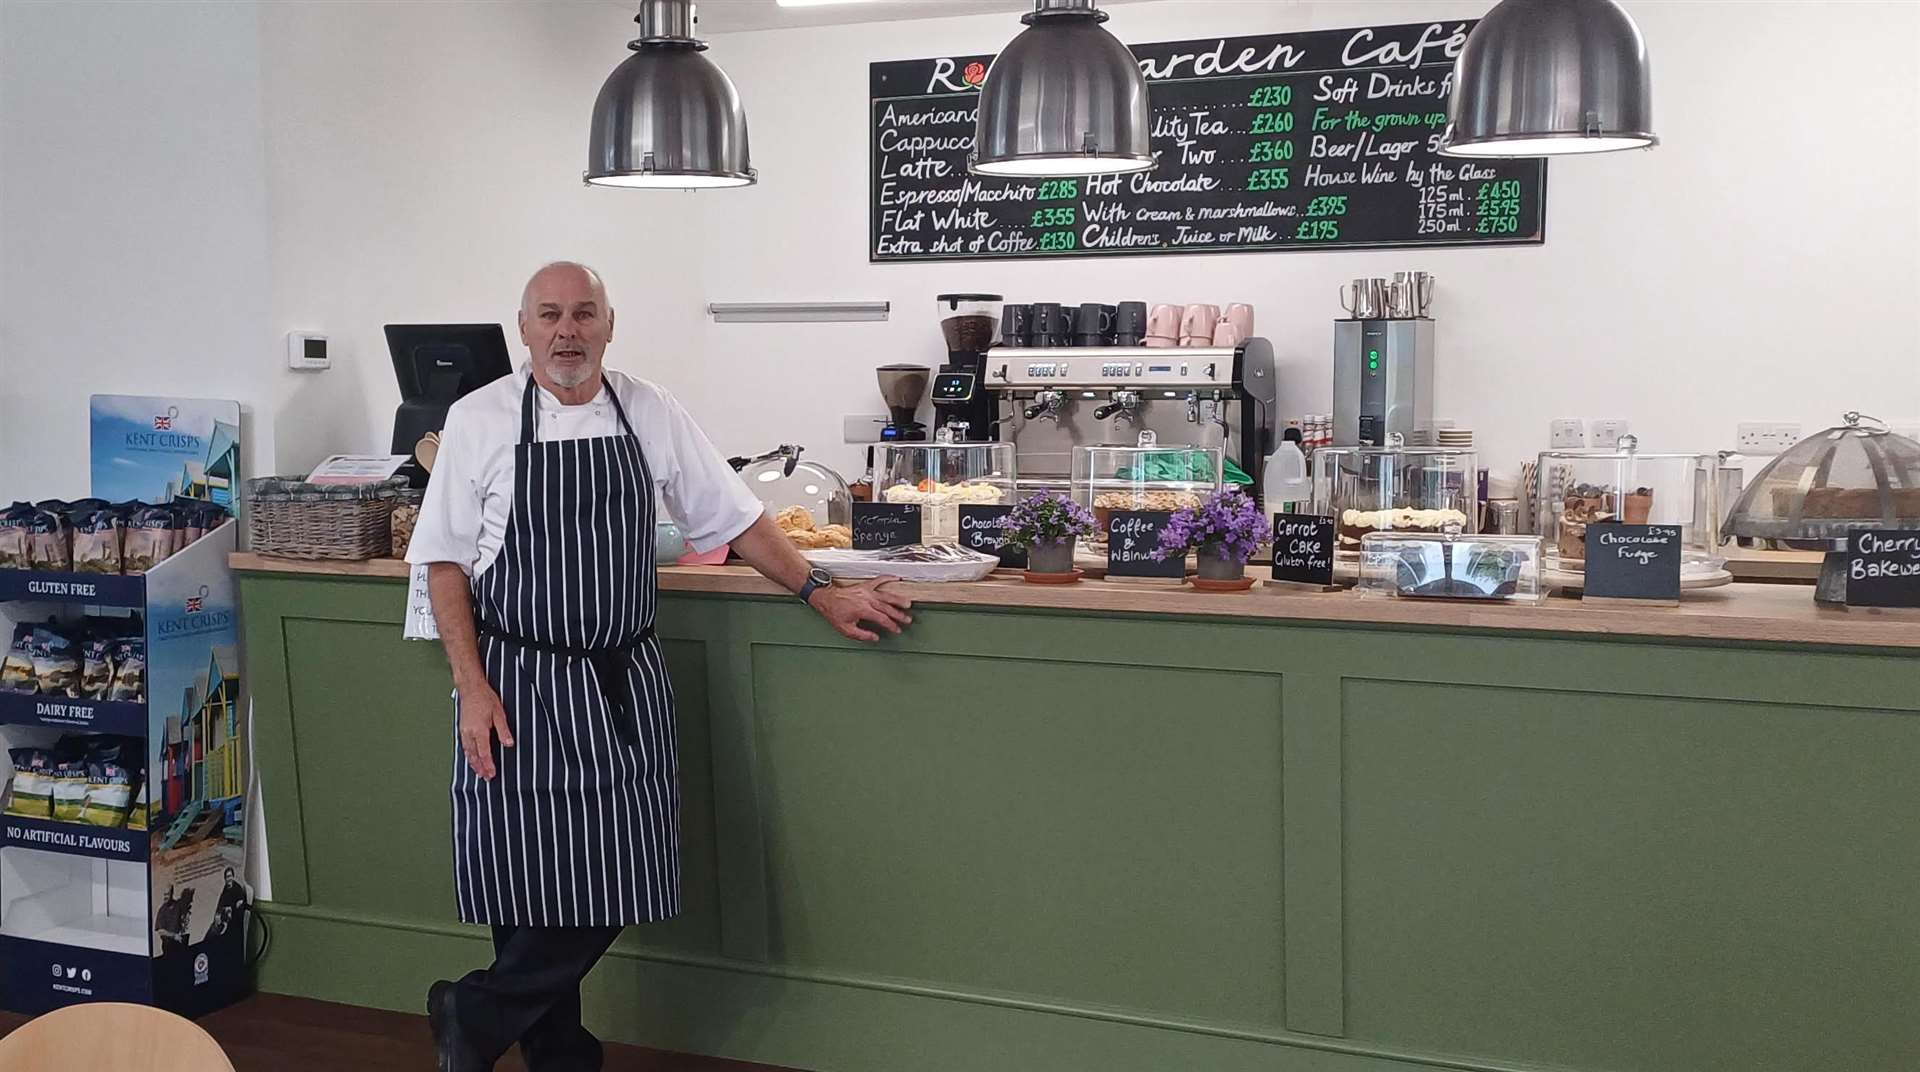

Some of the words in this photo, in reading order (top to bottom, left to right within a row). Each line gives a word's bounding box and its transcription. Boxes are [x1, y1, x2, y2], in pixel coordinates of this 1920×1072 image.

[1137, 40, 1306, 80] arden
[1313, 75, 1358, 103] Soft
[1367, 72, 1436, 99] Drinks
[1151, 115, 1188, 142] lity
[1189, 112, 1228, 136] Tea
[1312, 107, 1342, 131] For
[1344, 110, 1371, 131] the
[1372, 113, 1422, 132] grown
[1424, 112, 1446, 129] up
[1177, 140, 1217, 165] Two
[881, 155, 952, 179] Latte
[1304, 163, 1357, 187] House
[1361, 162, 1397, 185] Wine
[1405, 160, 1424, 187] by
[1429, 162, 1455, 184] the
[1459, 163, 1496, 181] Glass
[1085, 174, 1122, 196] Hot
[1130, 171, 1221, 195] Chocolate
[881, 209, 925, 232] Flat
[931, 207, 998, 231] White
[1082, 200, 1132, 224] With
[1185, 206, 1194, 219] &
[1198, 202, 1297, 220] marshmallows
[878, 234, 923, 254] Extra
[929, 235, 964, 253] shot
[969, 234, 985, 253] of
[988, 231, 1037, 252] Coffee
[1172, 227, 1216, 246] Juice
[1219, 231, 1236, 243] or
[1237, 225, 1278, 243] Milk
[126, 431, 157, 446] KENT
[160, 433, 200, 448] CRISPS
[1111, 517, 1154, 538] Coffee
[1278, 519, 1319, 536] Carrot
[1123, 538, 1135, 550] &
[1289, 538, 1321, 555] Cake
[1618, 546, 1658, 565] Fudge
[1307, 555, 1331, 571] free!
[1851, 558, 1920, 580] Bakewe
[28, 580, 68, 595] GLUTEN
[70, 582, 96, 596] FREE
[158, 617, 188, 634] KENT
[191, 611, 229, 630] CRISPS
[36, 702, 67, 716] DAIRY
[69, 705, 94, 719] FREE
[7, 826, 21, 839] NO
[23, 828, 77, 846] ARTIFICIAL
[79, 835, 130, 853] FLAVOURS
